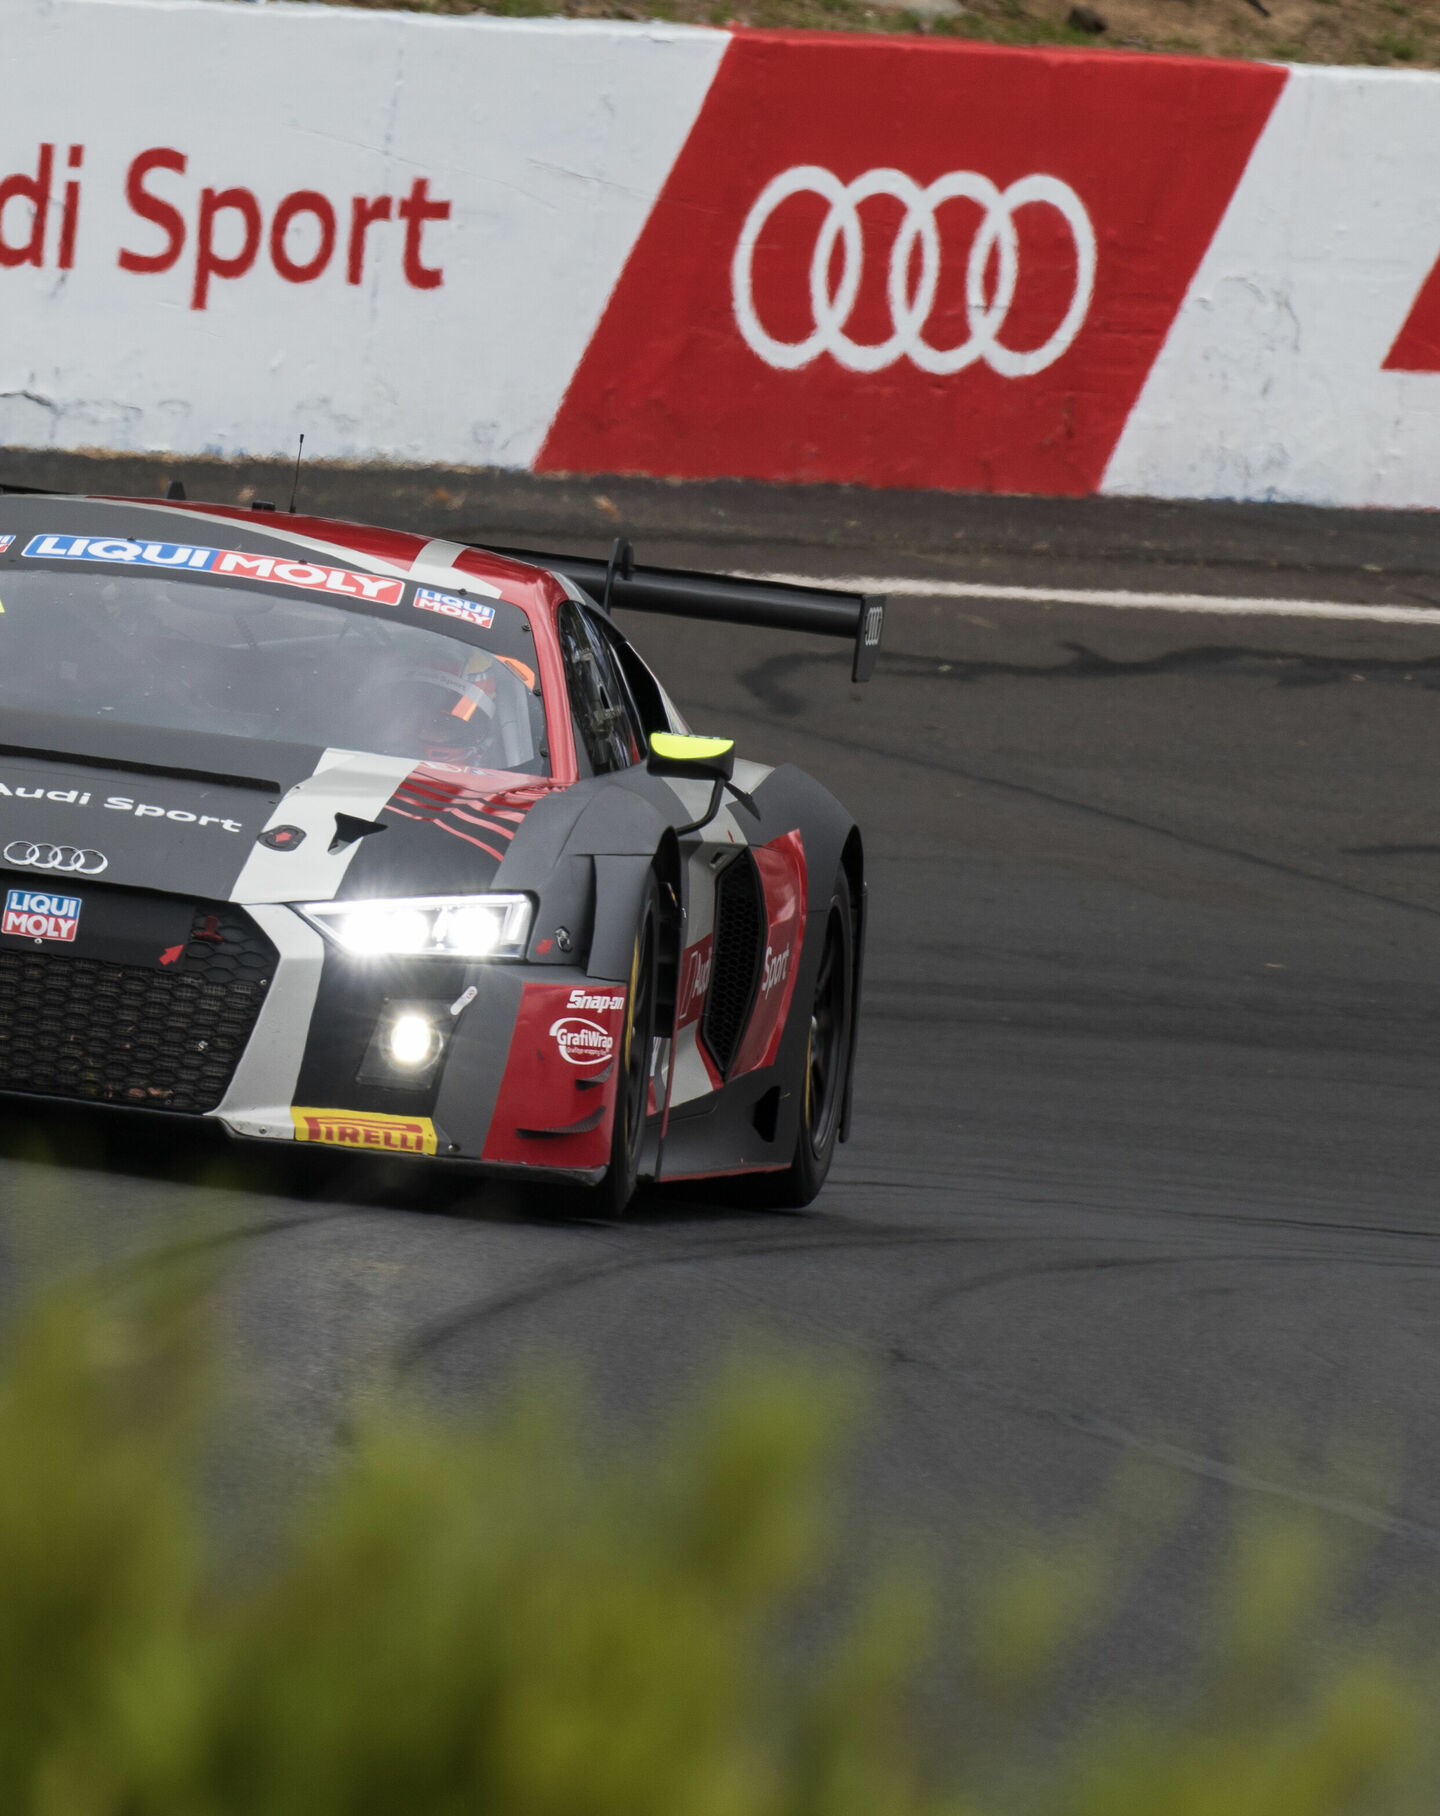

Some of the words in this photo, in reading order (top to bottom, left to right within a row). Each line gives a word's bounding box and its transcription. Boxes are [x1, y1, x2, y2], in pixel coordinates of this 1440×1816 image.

[118, 146, 451, 310] Sport
[35, 537, 213, 569] LIQUI
[219, 552, 397, 598] MOLY
[419, 599, 490, 624] MOLY
[420, 588, 491, 617] LIQUI
[103, 797, 243, 833] Sport
[10, 892, 77, 917] LIQUI
[5, 911, 76, 938] MOLY
[761, 942, 790, 1001] Sport
[566, 989, 624, 1013] Snap-on
[556, 1028, 613, 1053] GrafiWrap
[304, 1116, 424, 1151] PIRELLI
